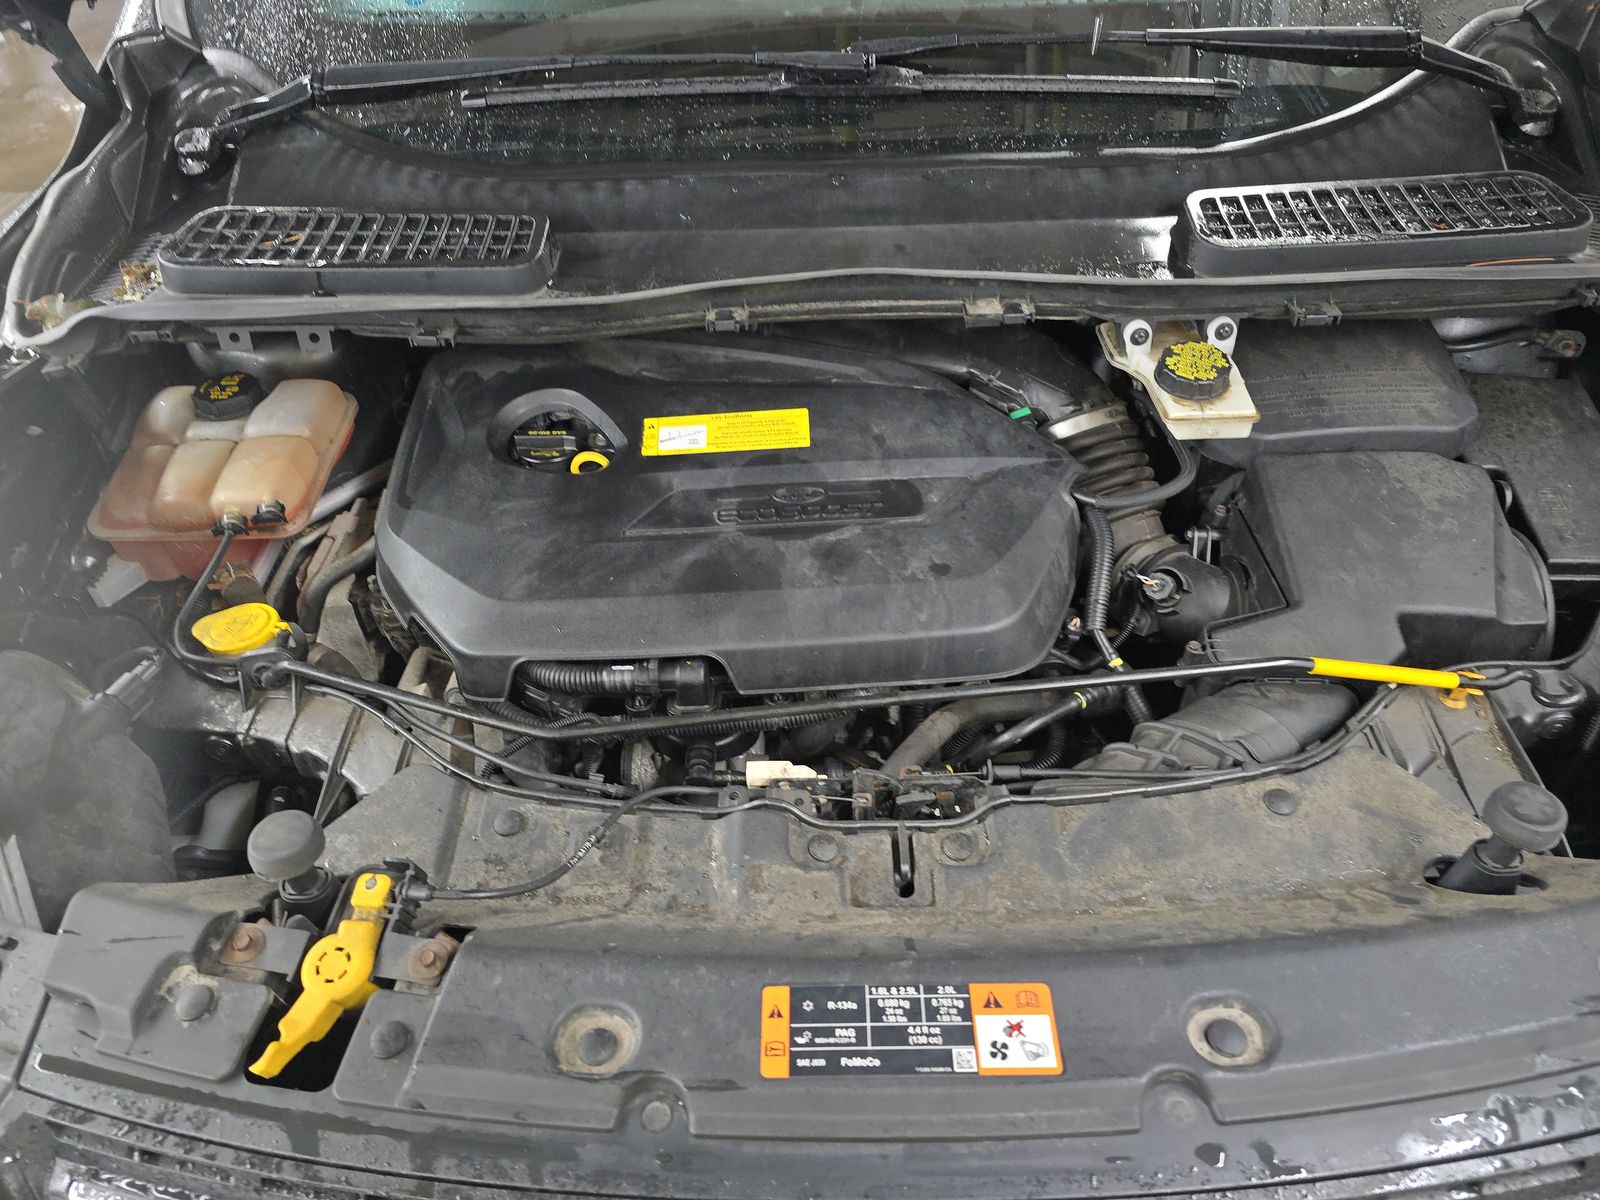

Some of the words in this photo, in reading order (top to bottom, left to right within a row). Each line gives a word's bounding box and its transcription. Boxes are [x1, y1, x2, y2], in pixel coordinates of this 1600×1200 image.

[890, 987, 898, 995] &
[899, 987, 918, 995] 2.5L
[937, 986, 957, 994] 2.0L
[827, 1001, 858, 1010] R-134a
[898, 999, 910, 1009] kg
[952, 999, 964, 1009] kg
[834, 1028, 856, 1037] PAG
[907, 1026, 921, 1034] 4.4
[840, 1057, 881, 1067] FoMoCo
